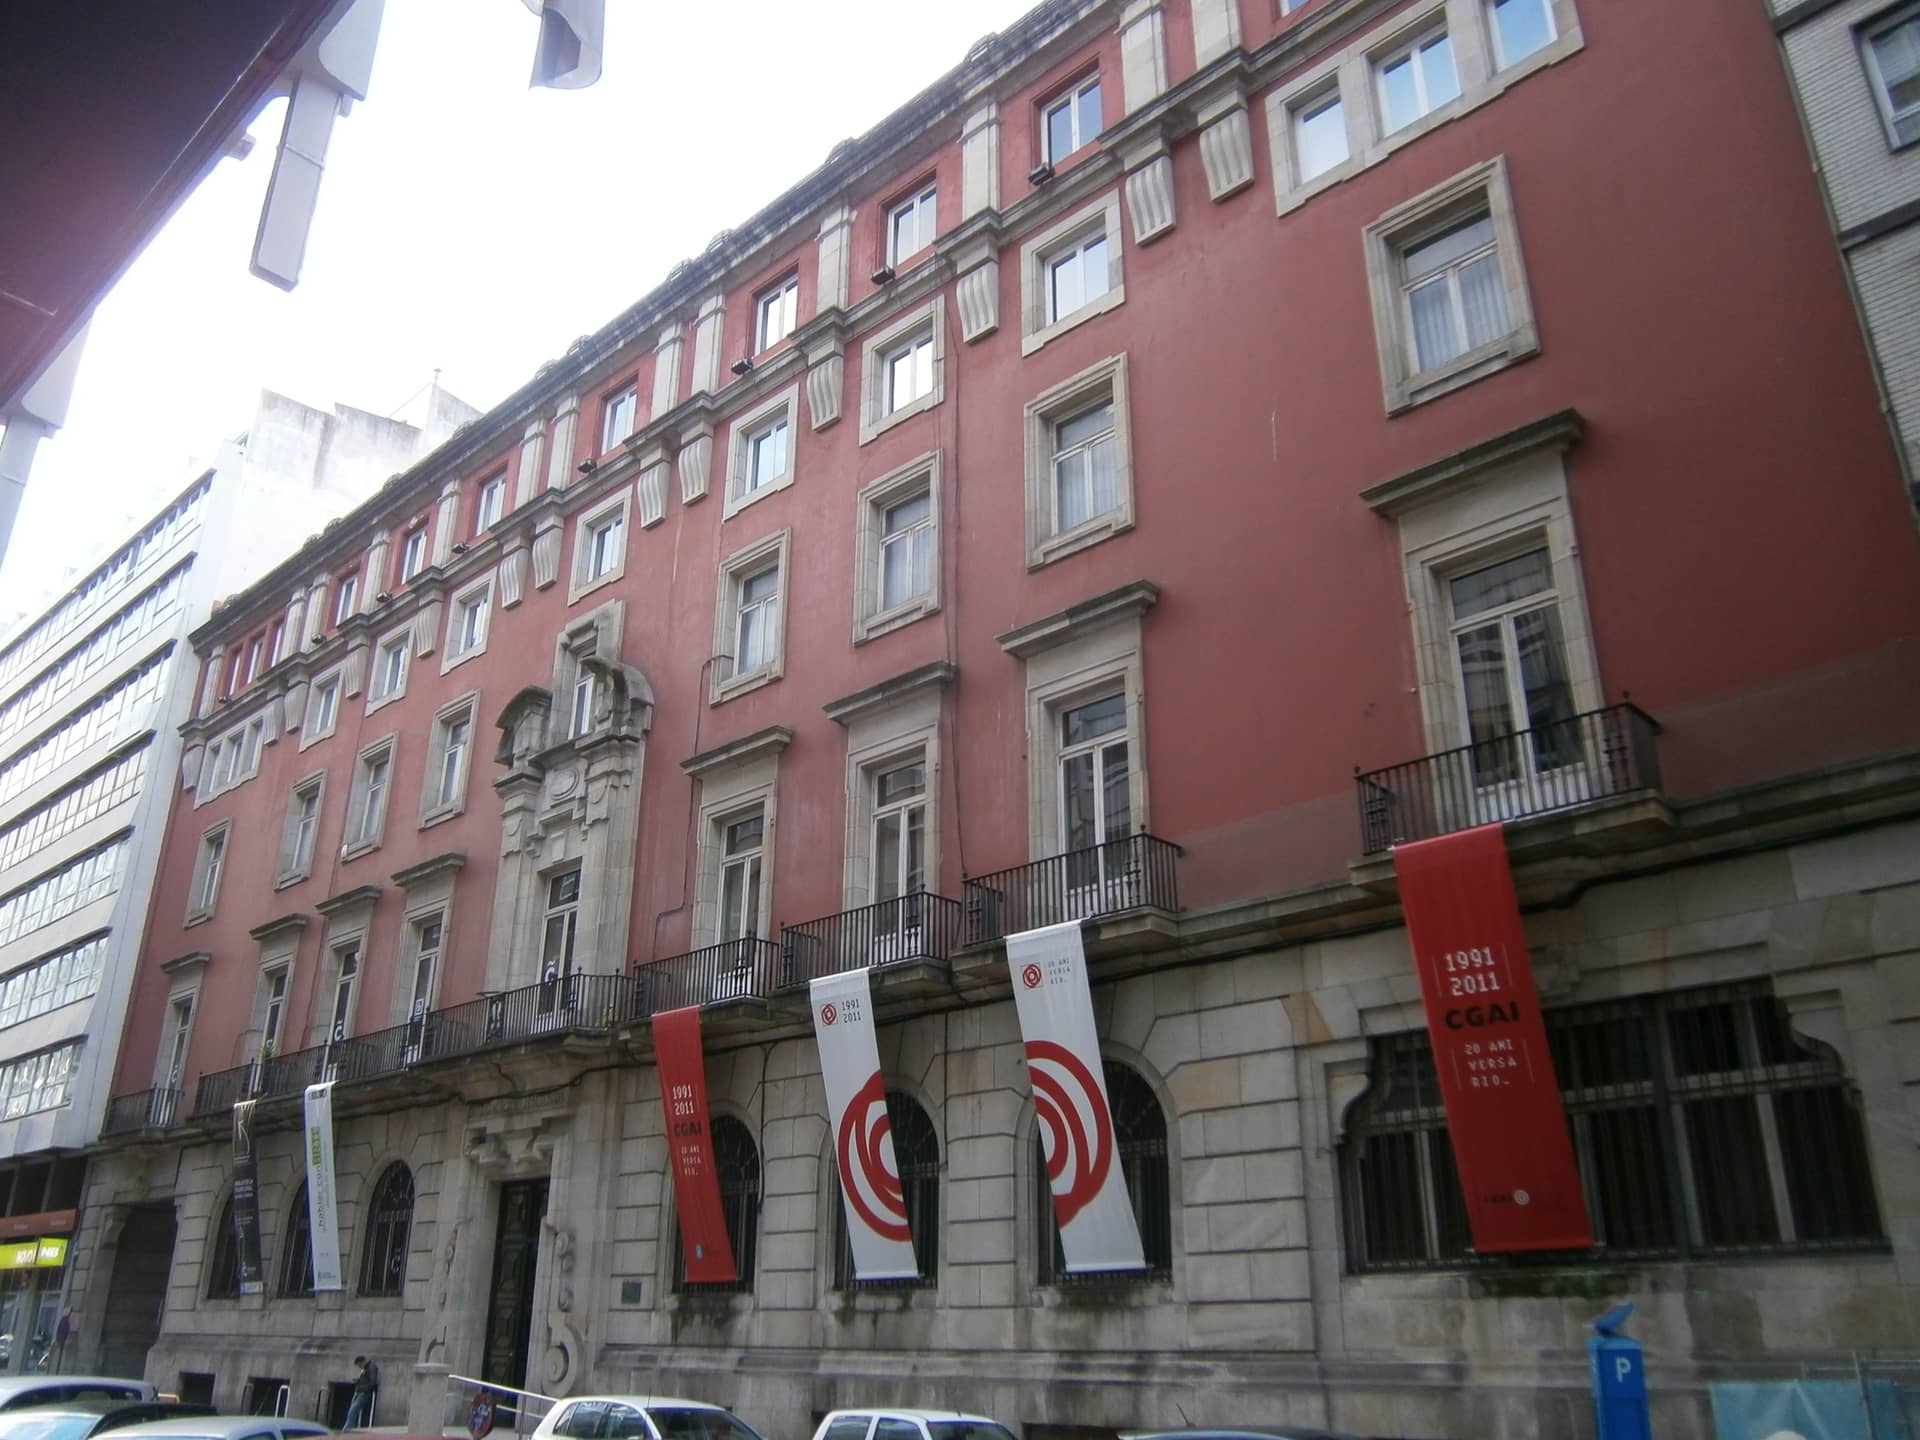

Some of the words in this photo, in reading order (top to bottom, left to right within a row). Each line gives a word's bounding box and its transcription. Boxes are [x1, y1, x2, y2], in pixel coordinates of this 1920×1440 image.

[1445, 947, 1495, 972] 1991
[1450, 972, 1500, 996] 2011
[842, 997, 860, 1011] 1991
[843, 1011, 861, 1024] 2011
[1446, 1003, 1519, 1030] CGAI
[1465, 1044, 1481, 1056] 20
[1489, 1040, 1513, 1052] ANI
[1469, 1057, 1517, 1070] VERSA
[672, 1082, 692, 1100] 1991
[674, 1099, 694, 1116] 2011
[673, 1120, 702, 1137] CGAI
[1615, 1357, 1631, 1384] P
